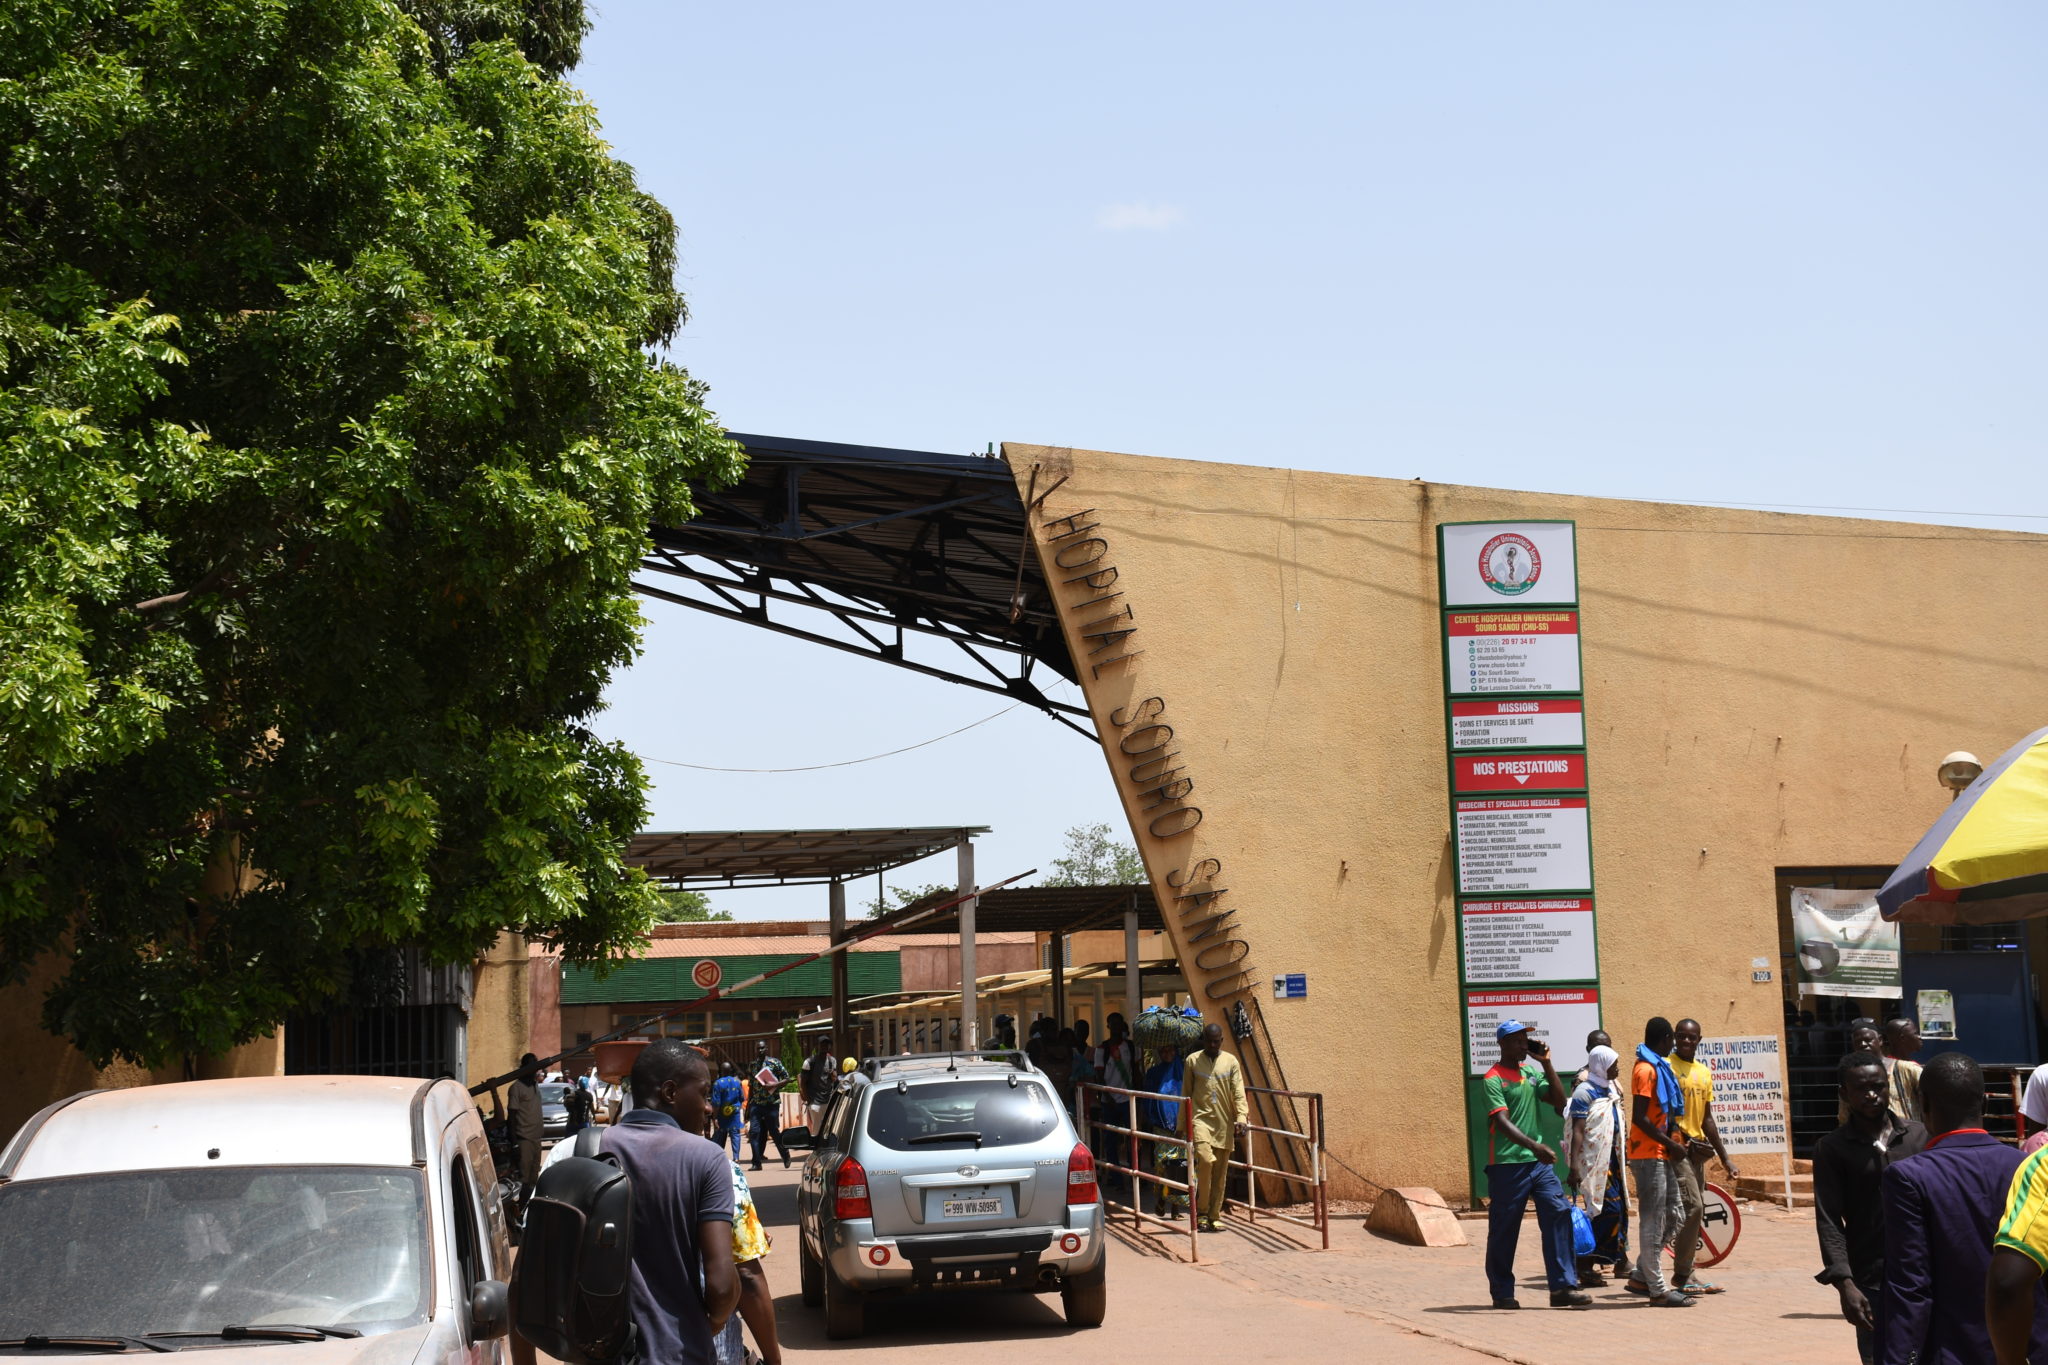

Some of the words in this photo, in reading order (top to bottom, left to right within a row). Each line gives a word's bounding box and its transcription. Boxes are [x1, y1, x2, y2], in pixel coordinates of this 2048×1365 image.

[1524, 614, 1569, 622] UNIVERSITAIRE
[1475, 624, 1497, 632] SOURO
[1498, 702, 1539, 713] MISSIONS
[1043, 508, 1146, 681] HOPITAL
[1110, 696, 1203, 837] SOURO
[1166, 858, 1263, 999] SANOU
[1473, 762, 1495, 775] NOS
[1498, 760, 1568, 774] PRESTATIONS
[1698, 1042, 1724, 1055] ITALIER
[1726, 1040, 1778, 1054] UNIVERSITAIRE
[1711, 1058, 1742, 1071] SANOU
[1712, 1072, 1764, 1080] ONSULTATION
[1727, 1082, 1780, 1091] VENDREDI
[1743, 1103, 1773, 1111] MALADES
[1731, 1126, 1755, 1134] JOURS
